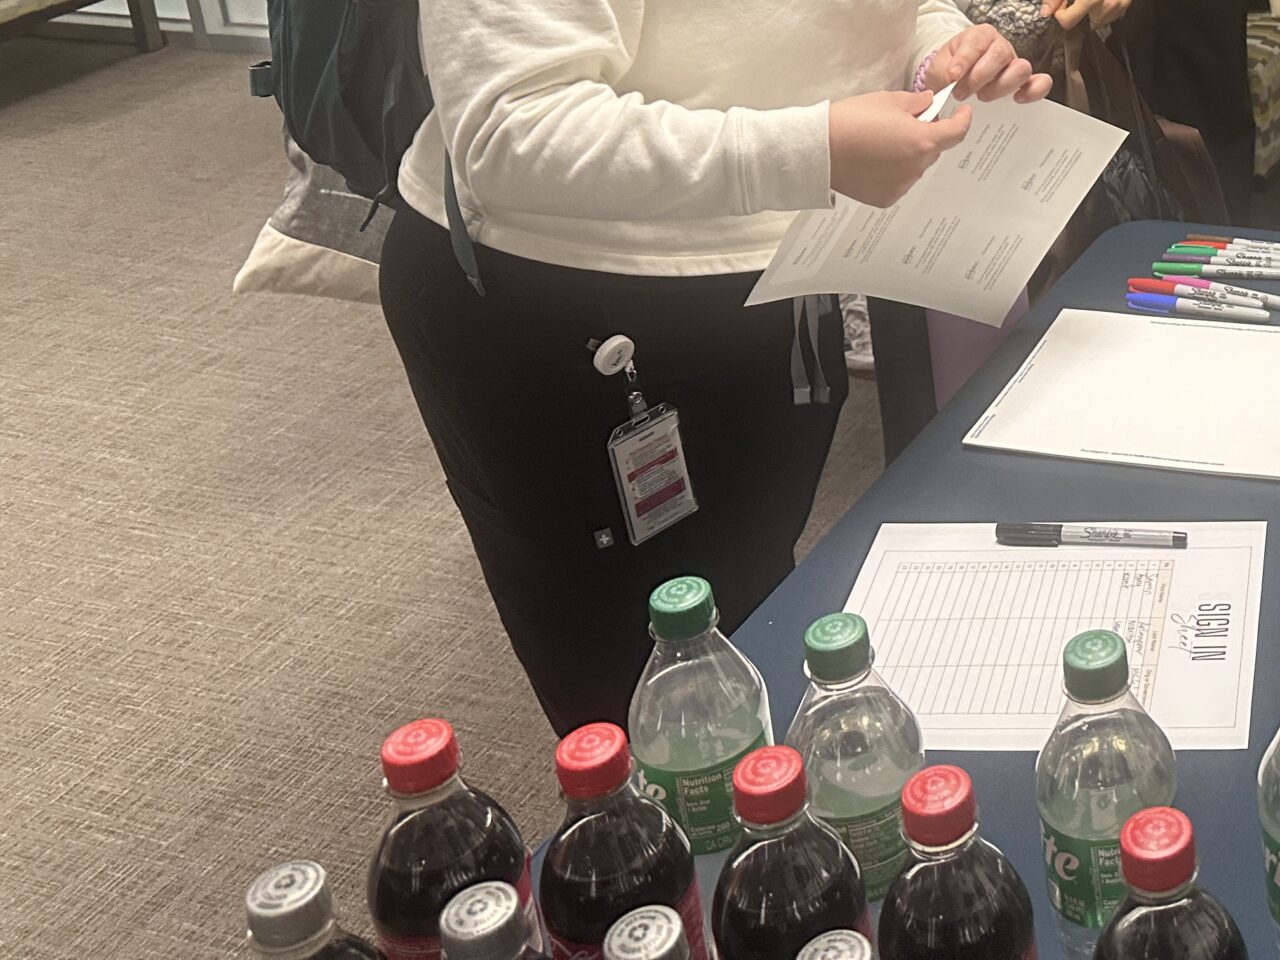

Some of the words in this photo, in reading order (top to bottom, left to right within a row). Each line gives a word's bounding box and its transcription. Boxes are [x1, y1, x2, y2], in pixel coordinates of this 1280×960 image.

[1194, 603, 1231, 638] SIGN
[1168, 613, 1205, 658] Sheet
[1192, 645, 1227, 661] IN
[682, 773, 722, 787] Nutrition
[684, 786, 709, 795] Facts
[1098, 848, 1120, 857] Nutri
[1099, 856, 1120, 866] Fact
